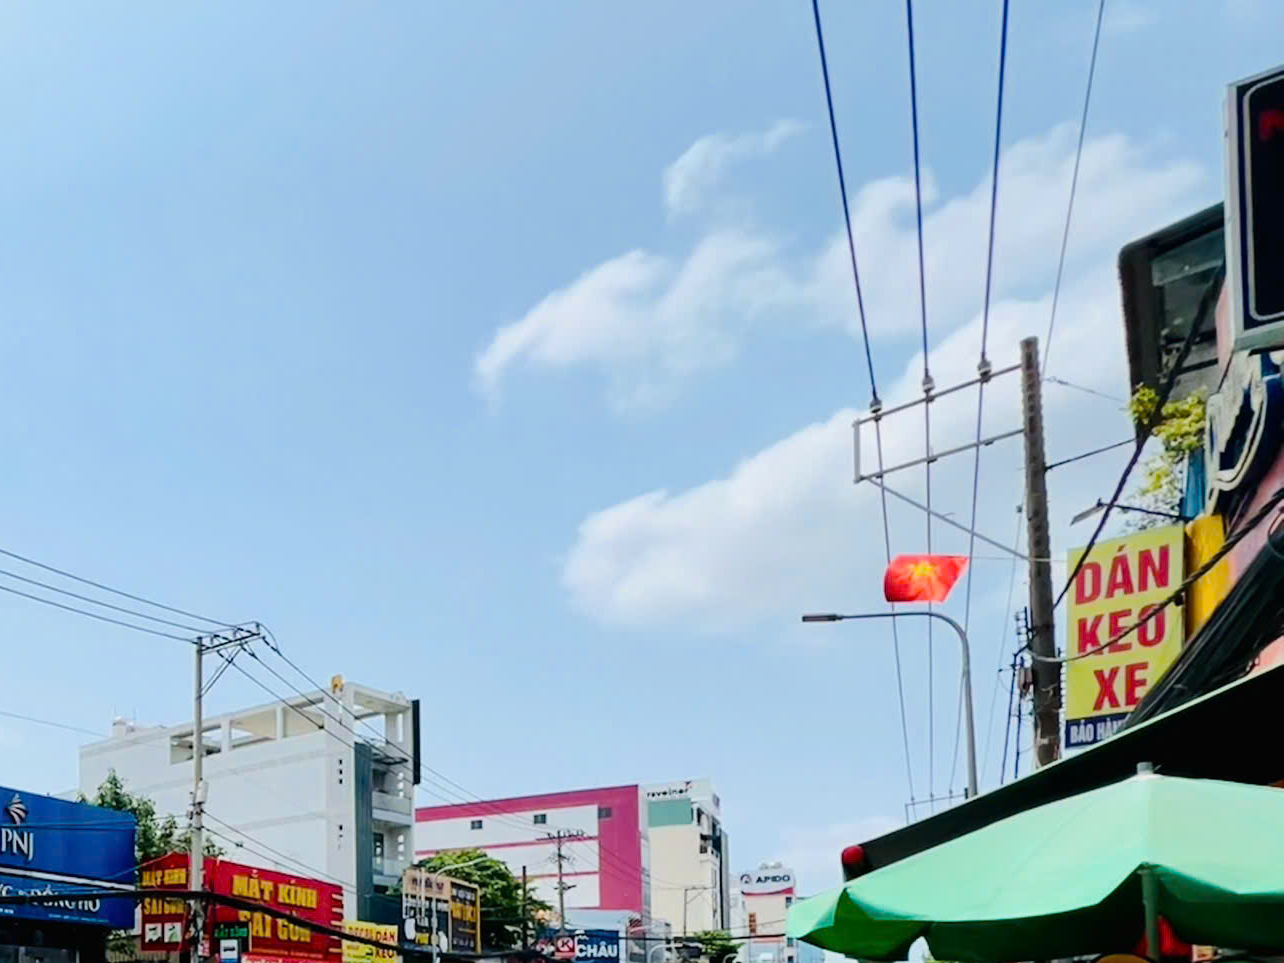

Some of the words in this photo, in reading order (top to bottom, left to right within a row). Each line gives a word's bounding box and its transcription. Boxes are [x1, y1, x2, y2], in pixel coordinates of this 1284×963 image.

[1075, 544, 1170, 605] DÁN
[1077, 604, 1166, 656] KEO
[1093, 662, 1149, 712] XE
[1, 828, 34, 860] PNJ
[277, 879, 317, 909] KÍNH
[576, 941, 617, 958] CHÂU
